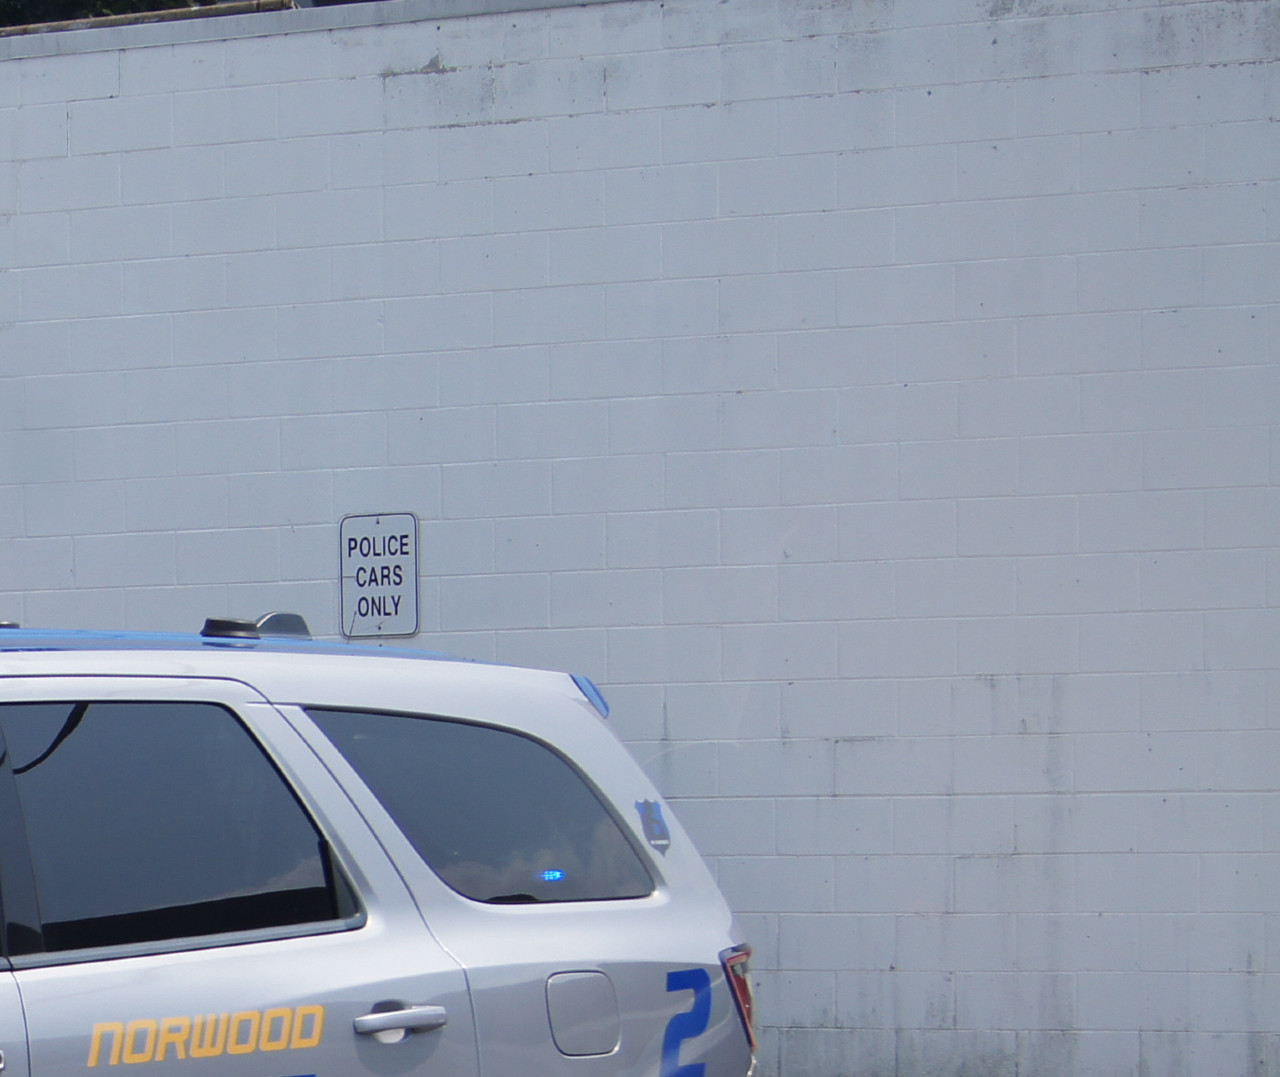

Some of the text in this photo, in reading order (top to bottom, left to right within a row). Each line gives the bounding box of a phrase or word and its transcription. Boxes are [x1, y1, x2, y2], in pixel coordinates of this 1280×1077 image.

[348, 534, 409, 558] POLICE
[356, 565, 403, 587] CARS
[358, 595, 401, 617] ONLY
[87, 1004, 324, 1068] NORWOOD
